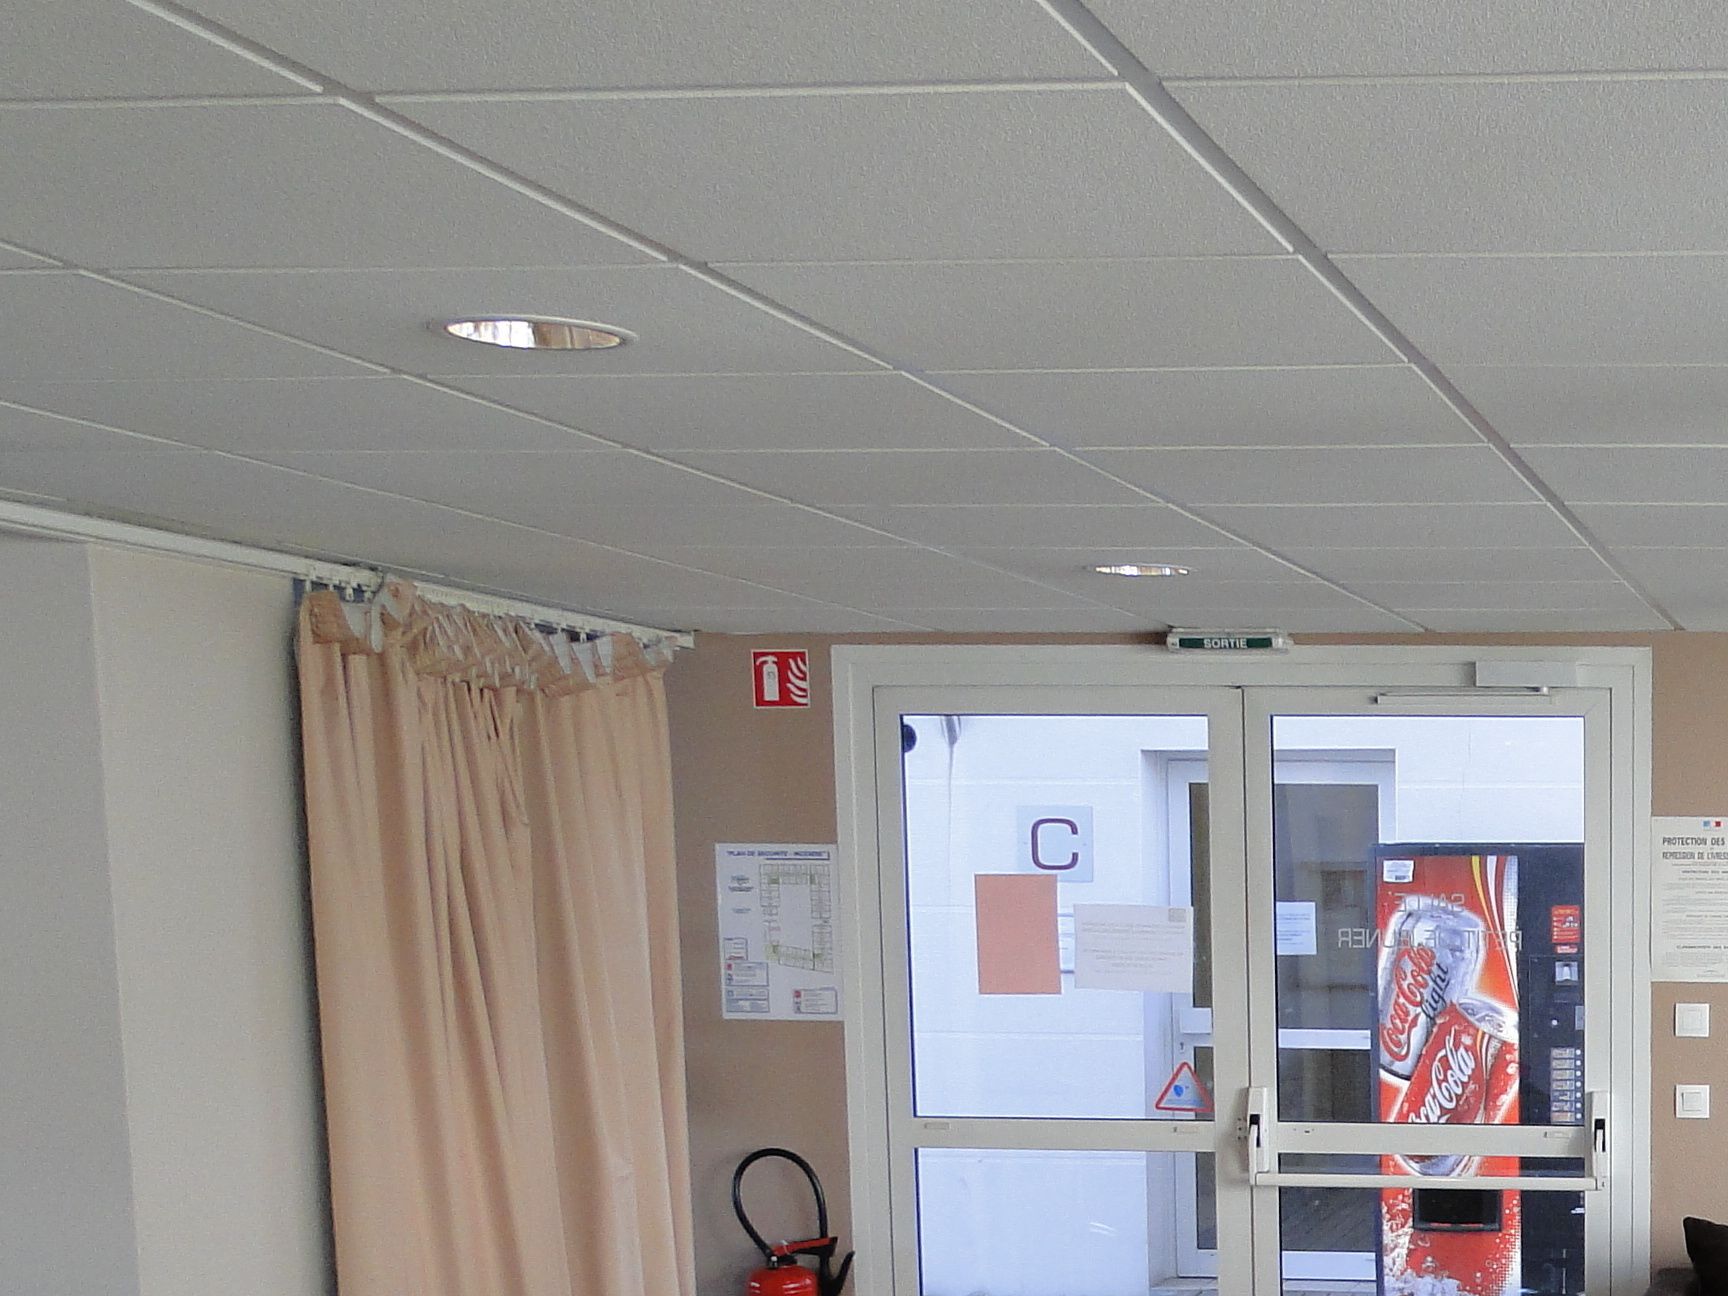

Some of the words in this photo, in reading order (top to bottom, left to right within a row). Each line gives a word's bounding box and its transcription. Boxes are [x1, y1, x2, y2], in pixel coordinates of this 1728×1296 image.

[1203, 638, 1248, 649] SORTIE
[1030, 817, 1080, 871] C
[1662, 836, 1707, 846] PROTECTION
[1711, 837, 1725, 846] DES
[1421, 963, 1450, 1019] light
